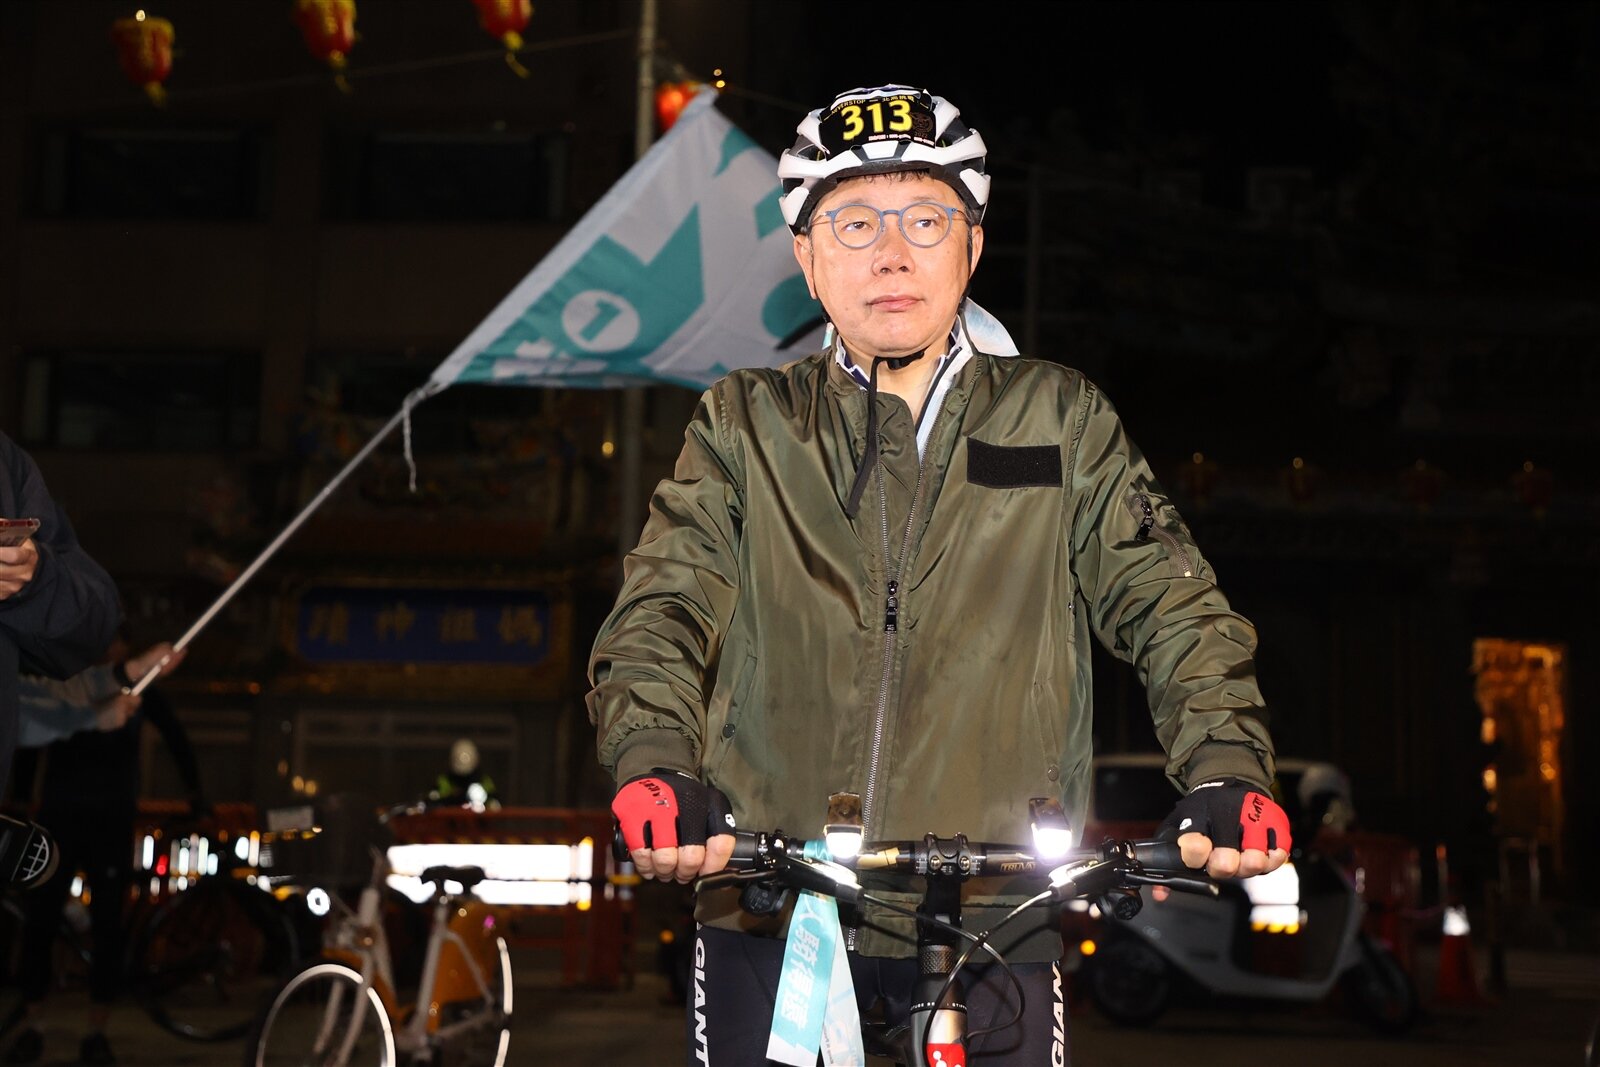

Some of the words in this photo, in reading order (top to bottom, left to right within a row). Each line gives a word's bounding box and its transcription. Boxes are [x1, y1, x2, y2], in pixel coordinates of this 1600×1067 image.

[841, 99, 913, 141] 313
[579, 299, 622, 341] 1
[694, 937, 710, 1067] GIANT
[1051, 960, 1065, 1067] GIAN
